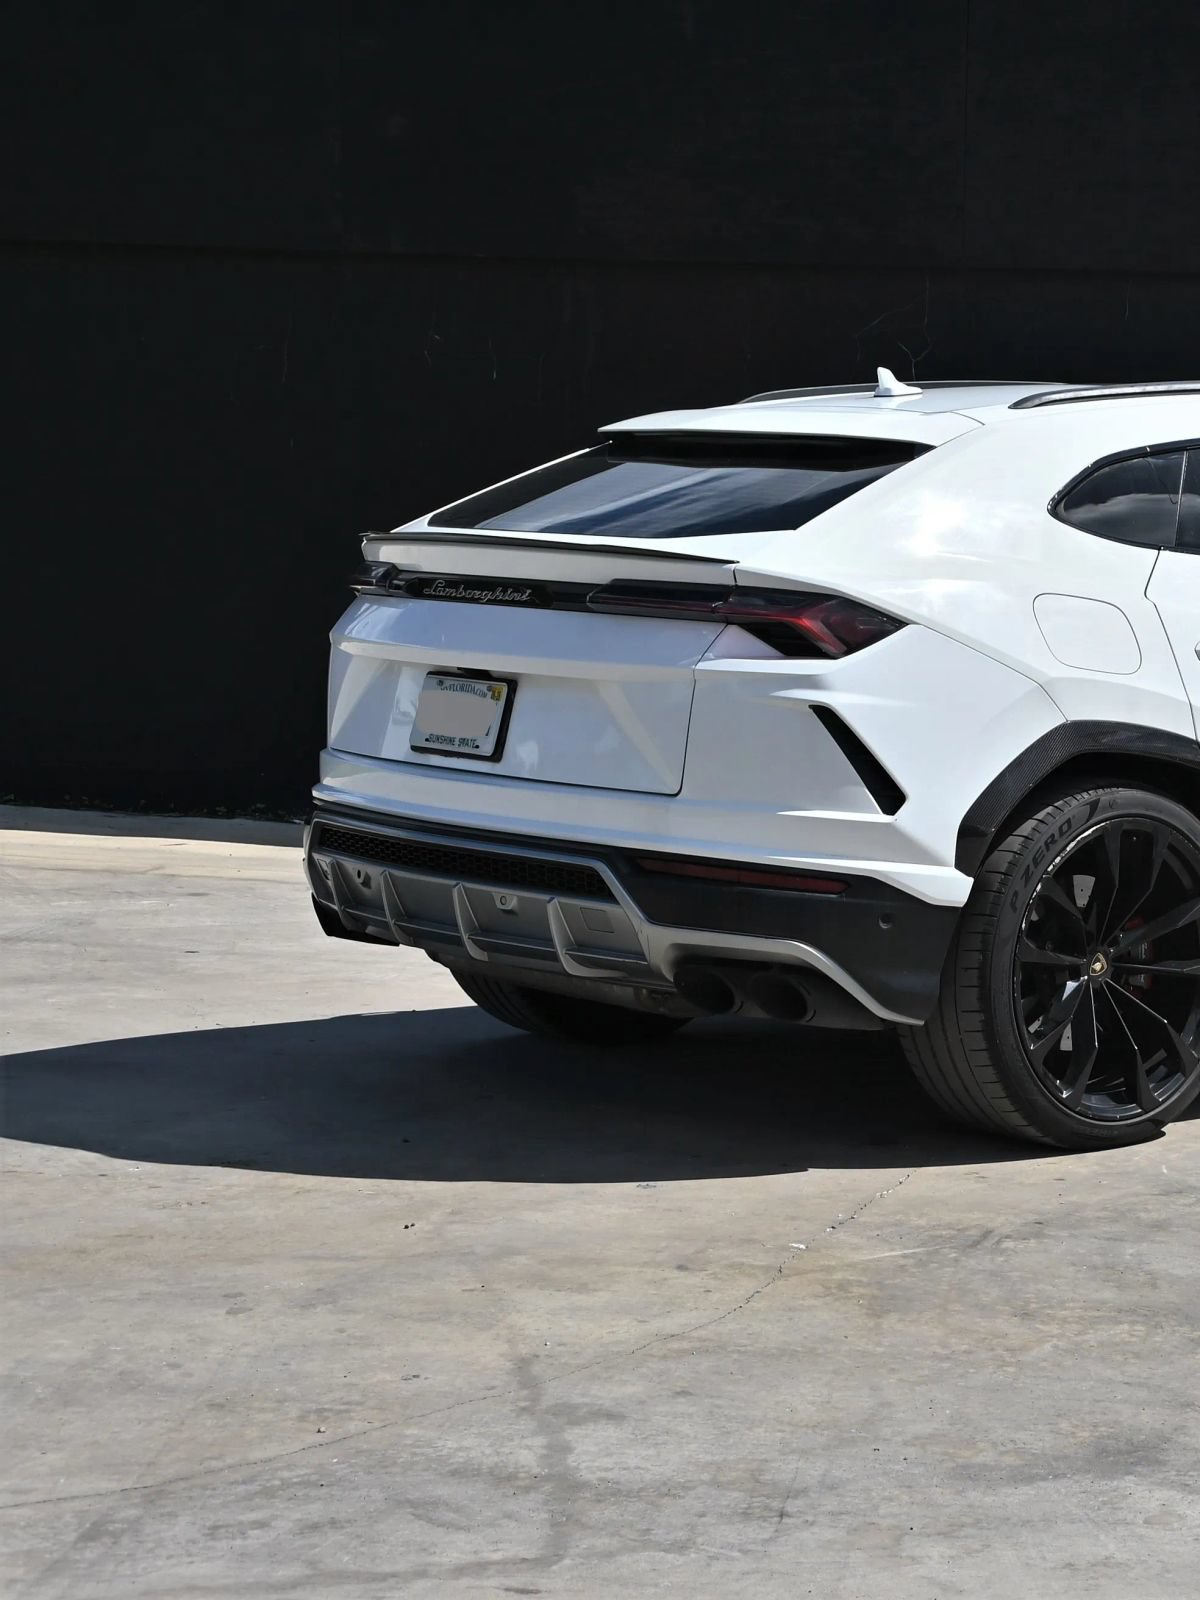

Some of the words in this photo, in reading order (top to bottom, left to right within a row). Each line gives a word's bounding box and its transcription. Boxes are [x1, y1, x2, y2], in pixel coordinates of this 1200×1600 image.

[422, 579, 533, 603] Lamborghini
[428, 733, 456, 746] SUNSHINE
[457, 737, 477, 748] STATE
[1021, 817, 1072, 888] ZERO
